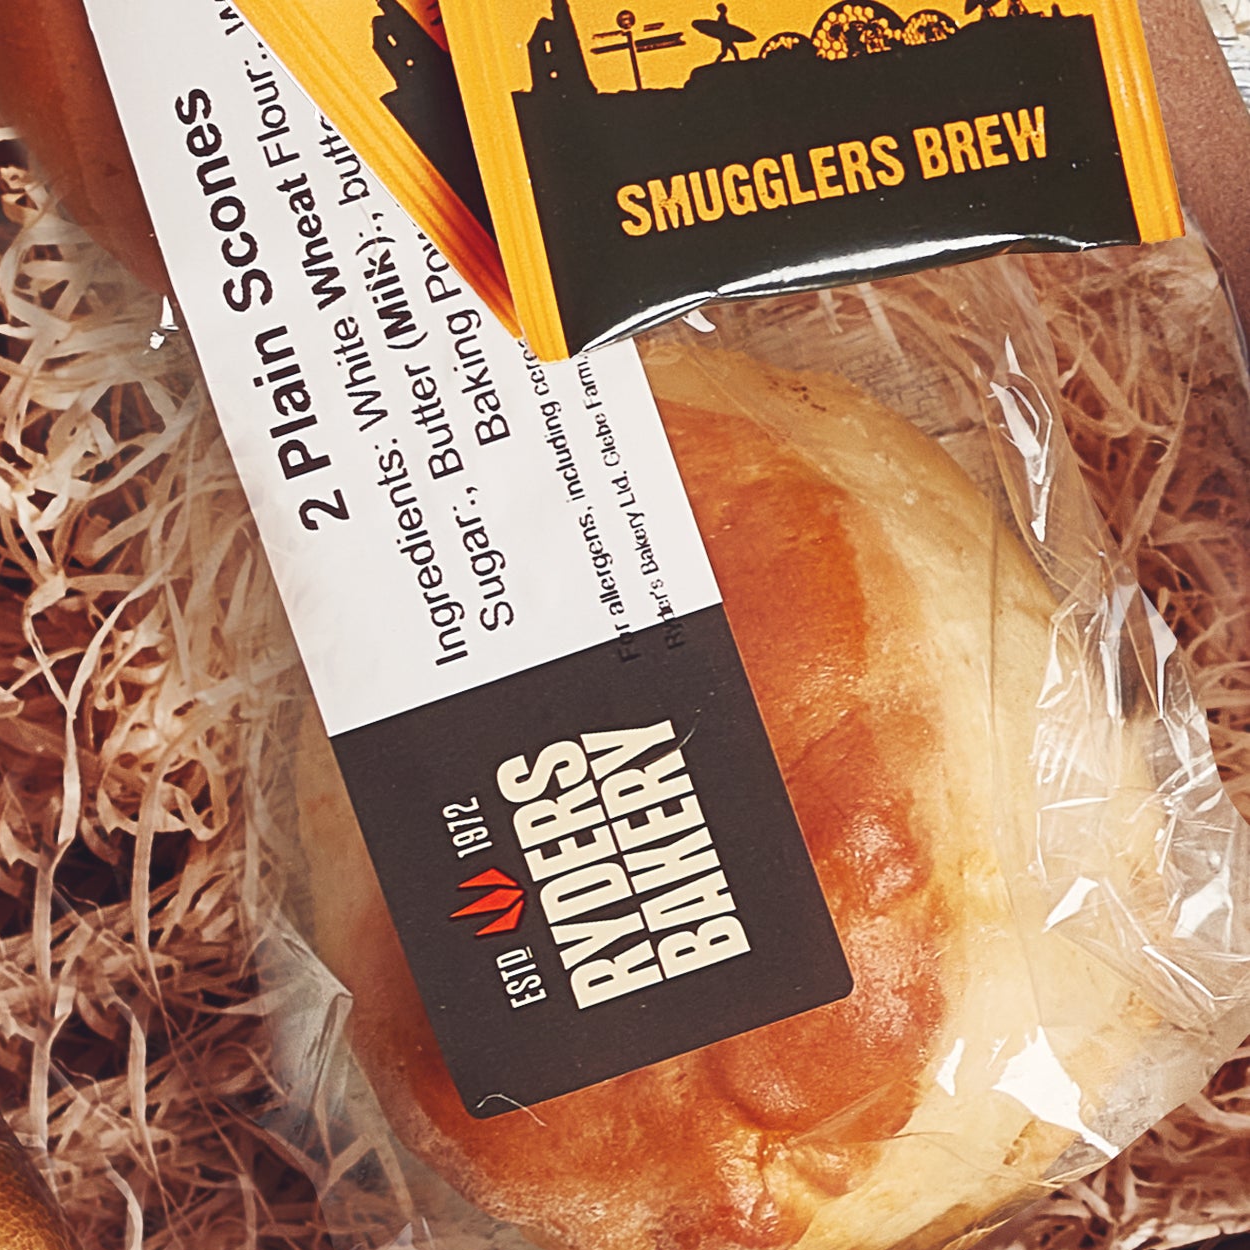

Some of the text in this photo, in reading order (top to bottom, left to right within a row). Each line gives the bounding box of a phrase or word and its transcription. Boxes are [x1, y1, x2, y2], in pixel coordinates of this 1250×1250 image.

[175, 89, 272, 311] Scones
[617, 106, 1046, 235] SMUGGLERS BREW
[277, 173, 346, 310] Wheat
[254, 326, 331, 479] Plain
[334, 317, 387, 431] White
[405, 365, 463, 479] Butter
[447, 310, 510, 445] Baking
[299, 490, 349, 530] 2
[540, 402, 585, 500] including
[375, 439, 467, 665] Ingredients:
[454, 487, 513, 630] Sugar:,
[580, 507, 624, 615] allergens,
[627, 513, 658, 575] Bakery
[612, 624, 643, 665] For
[443, 797, 546, 1008] ESTD 1972
[497, 741, 663, 1009] RYDERS
[581, 720, 750, 978] BAKERY
